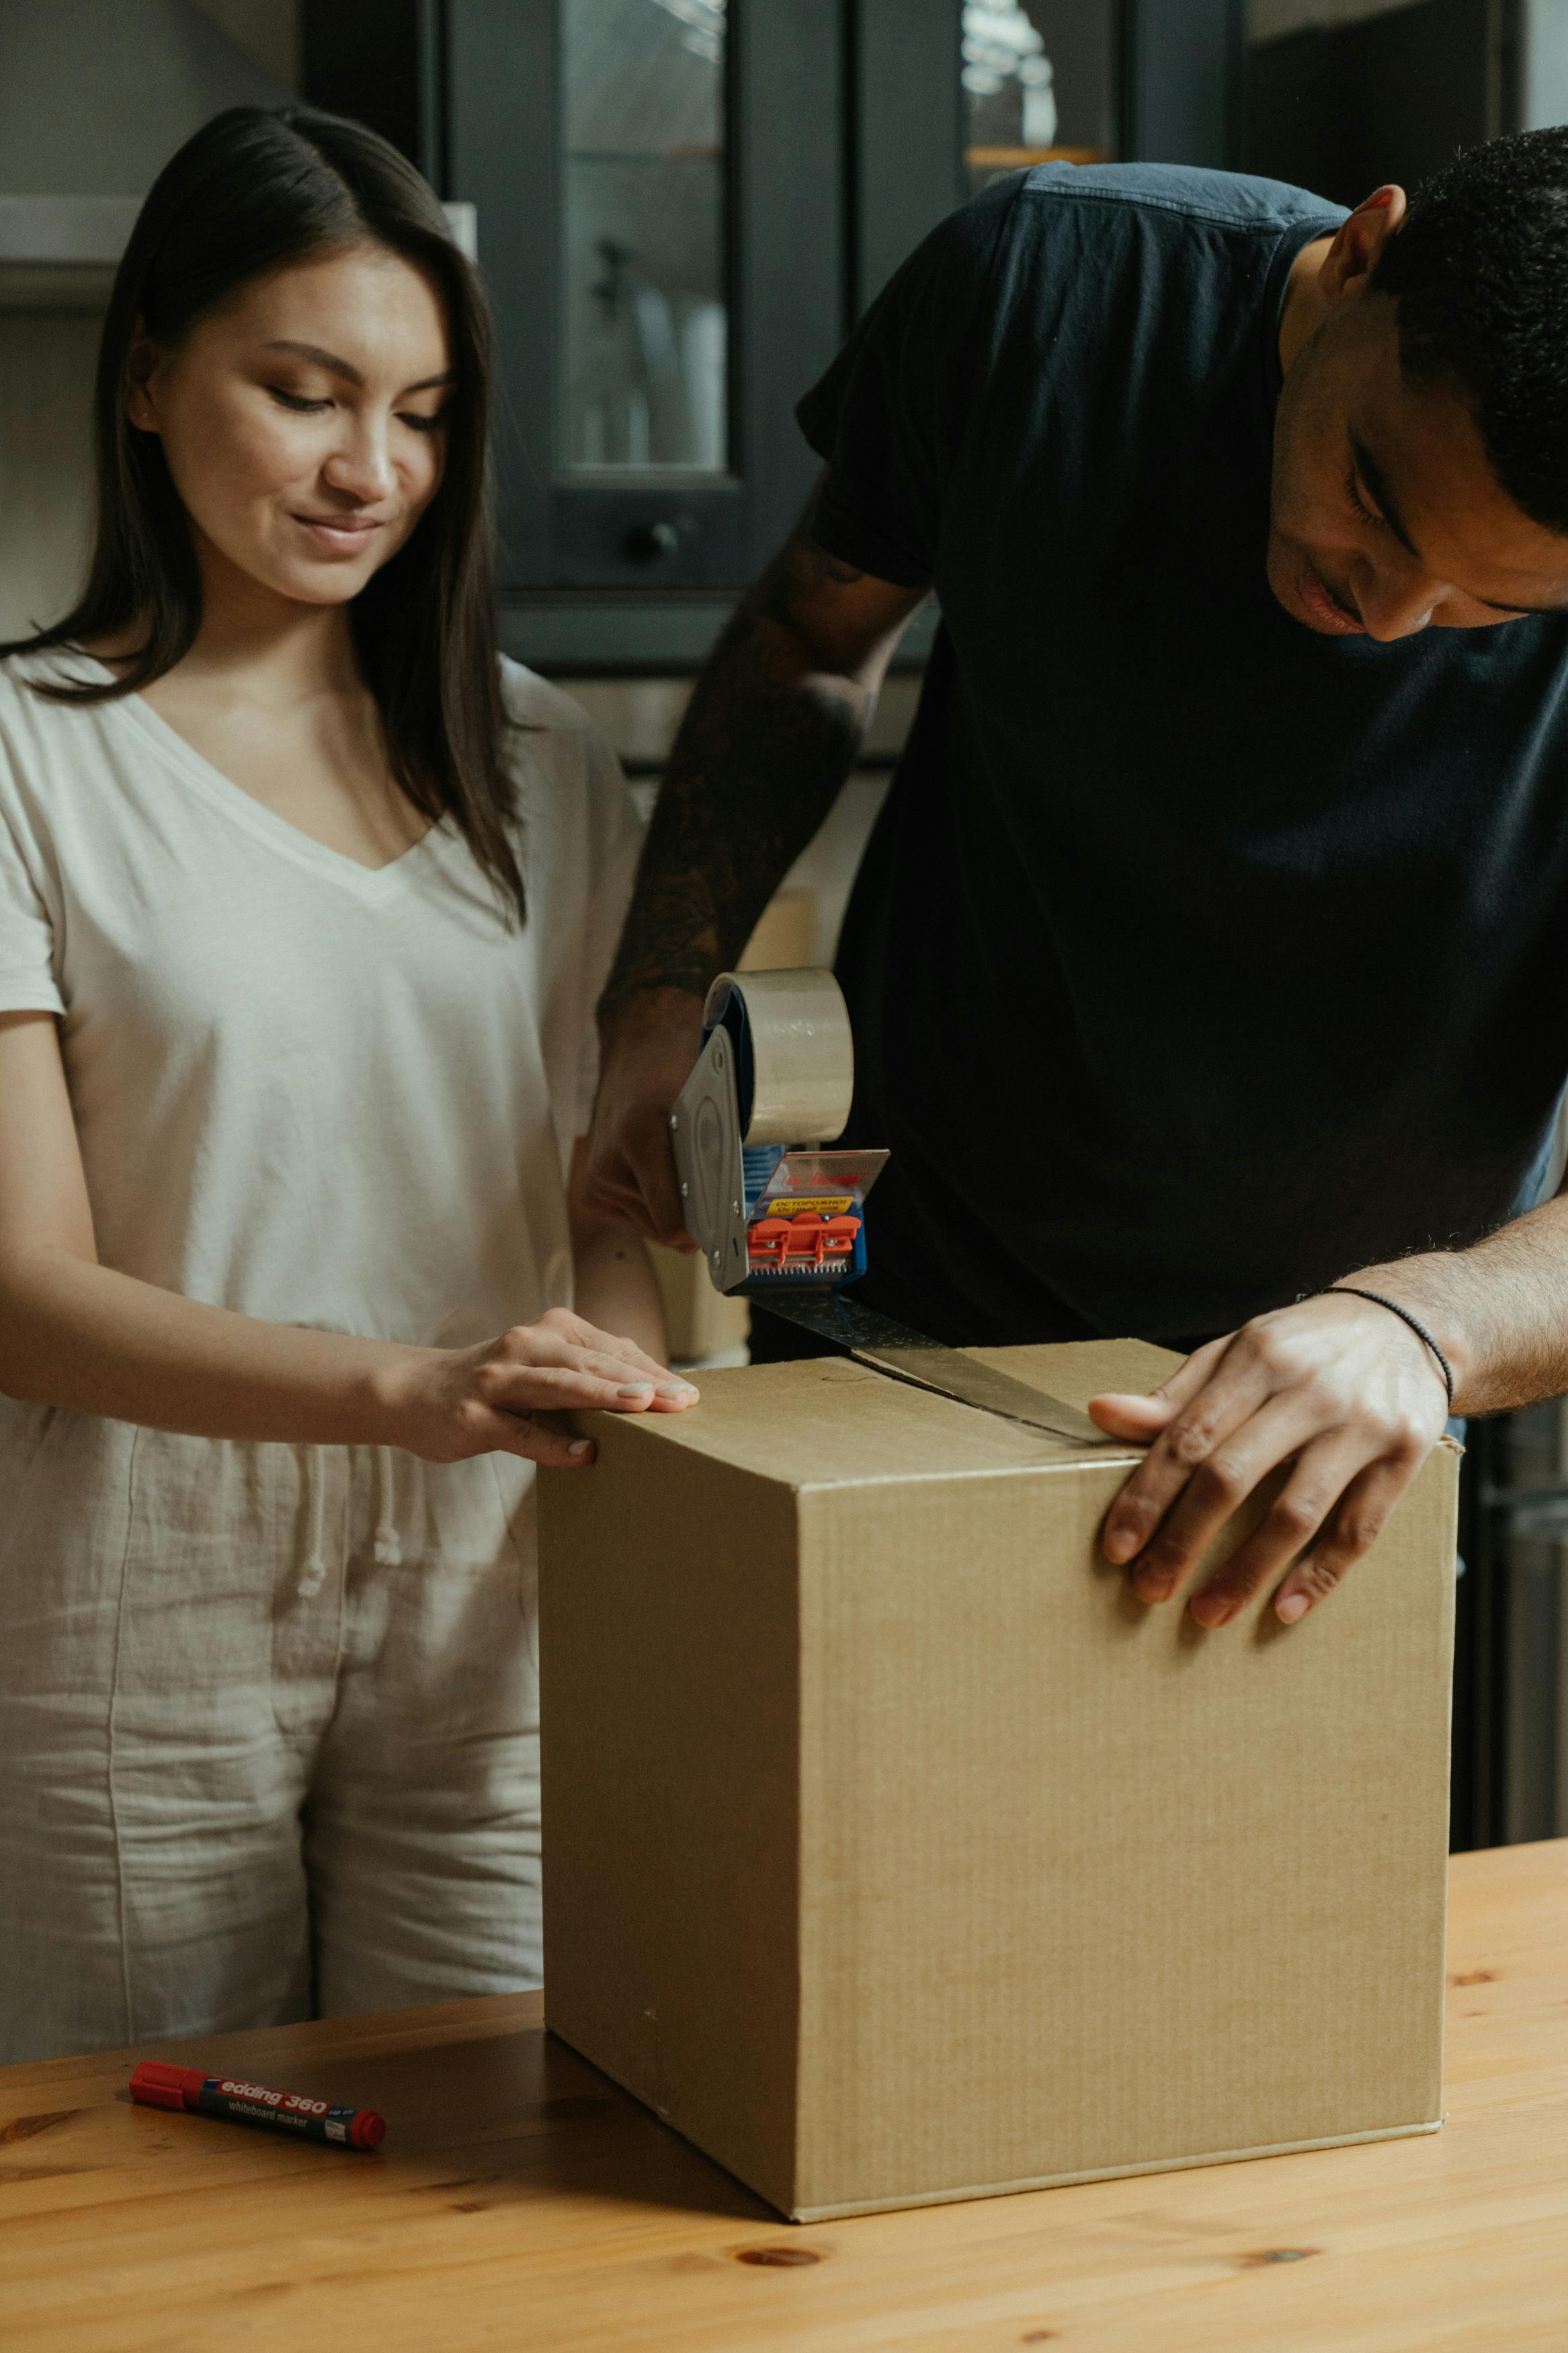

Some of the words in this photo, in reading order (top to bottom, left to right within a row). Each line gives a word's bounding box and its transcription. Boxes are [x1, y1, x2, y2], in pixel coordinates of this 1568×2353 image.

[776, 1199, 847, 1207] ОСТОРОЖНО!
[222, 2081, 284, 2106] edding
[285, 2096, 327, 2114] 360
[229, 2101, 276, 2120] whiteboard
[277, 2113, 308, 2128] marker
